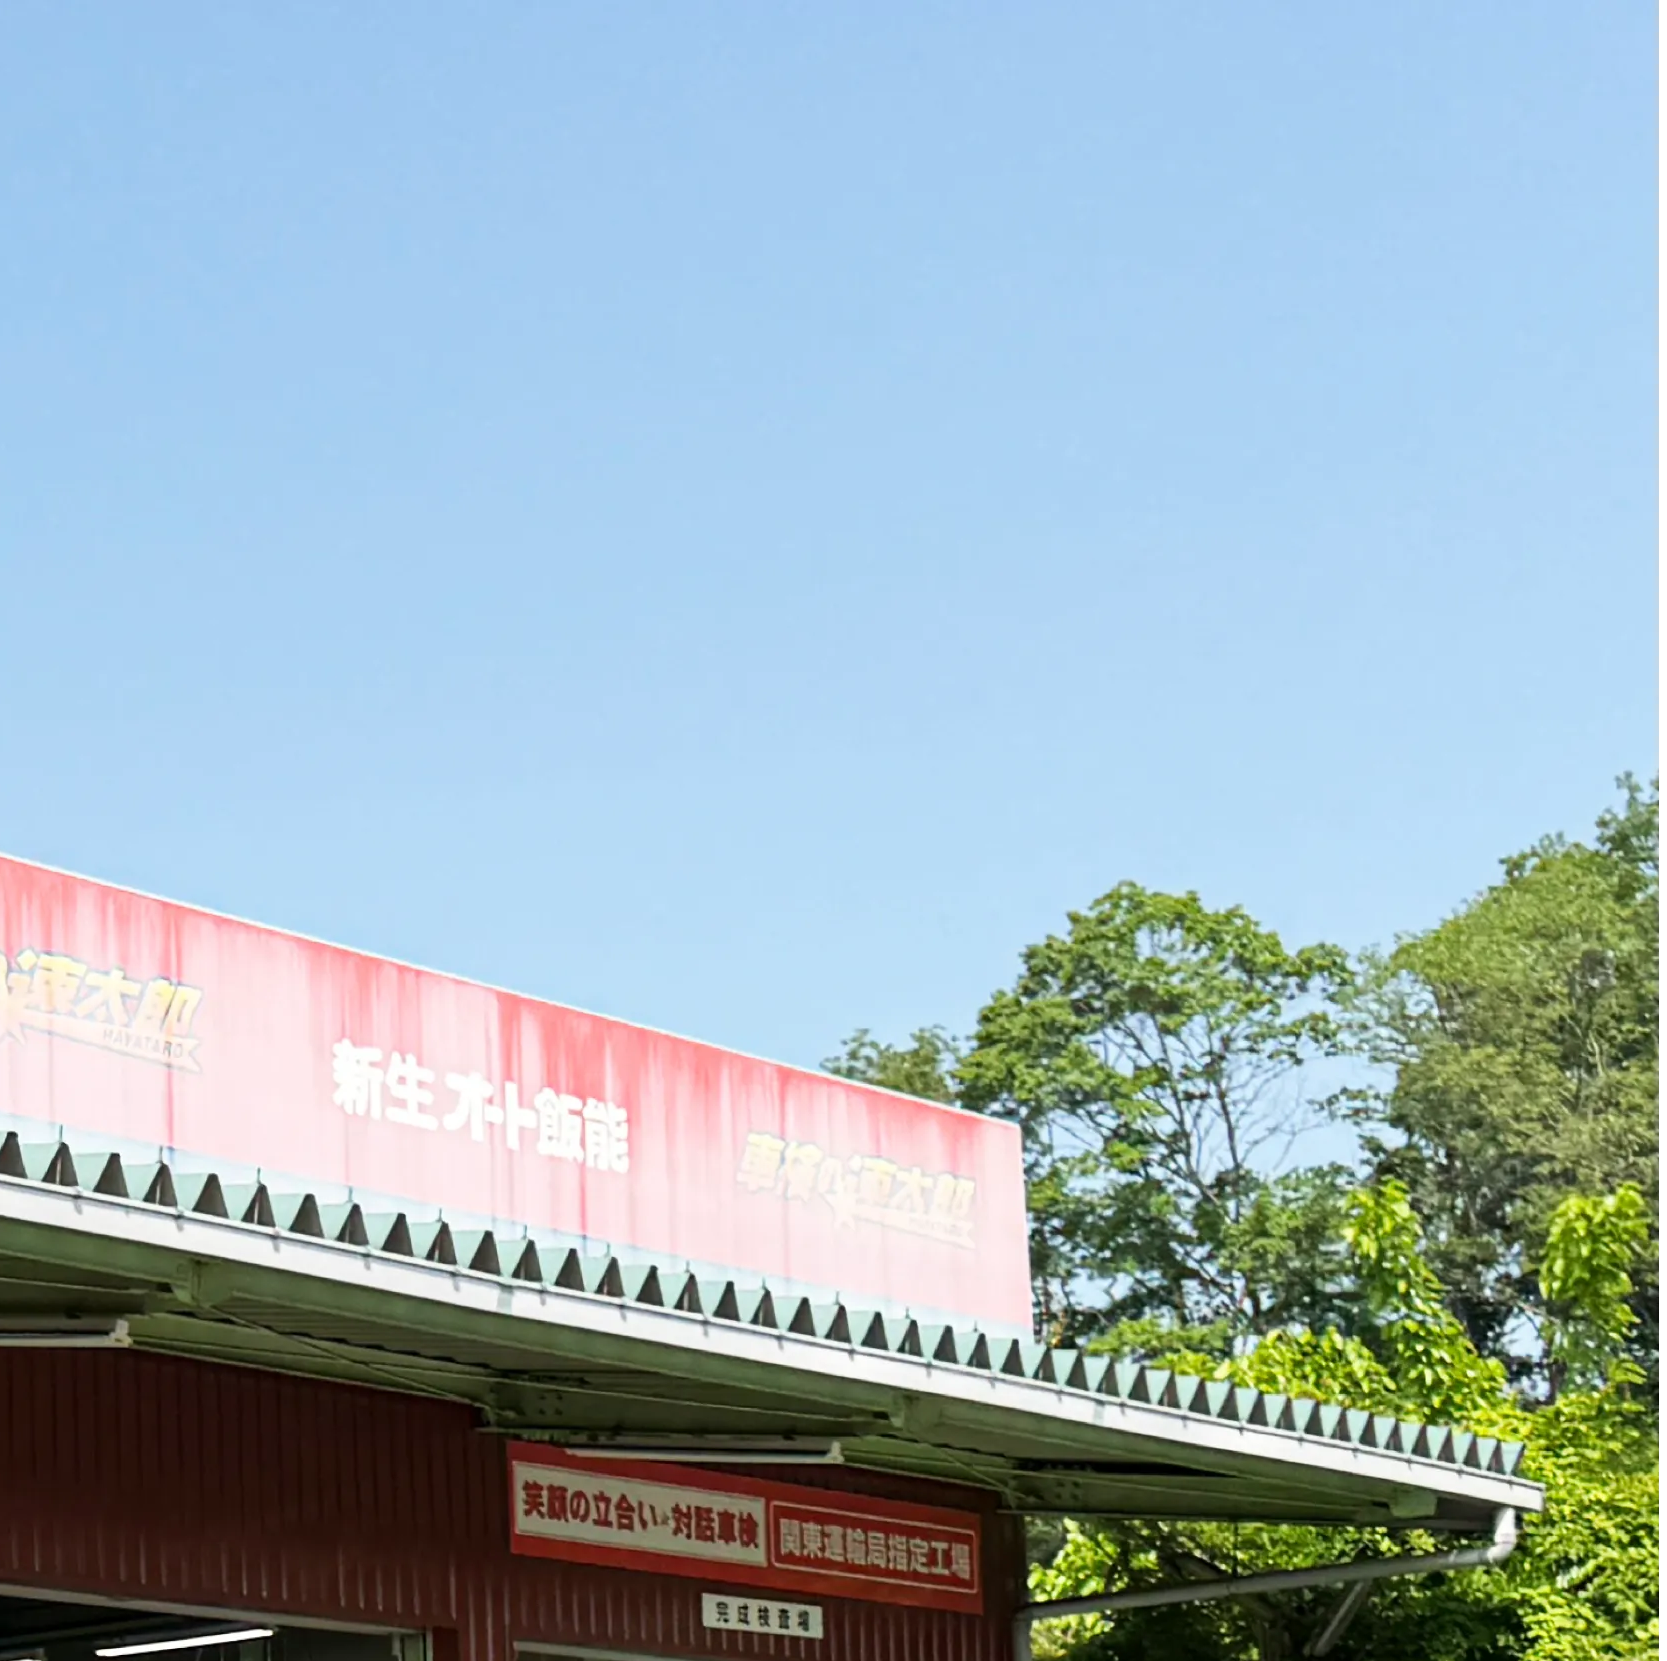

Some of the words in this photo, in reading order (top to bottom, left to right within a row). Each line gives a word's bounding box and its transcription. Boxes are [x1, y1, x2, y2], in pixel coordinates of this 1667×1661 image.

[104, 1028, 184, 1060] HAYATARO
[779, 1518, 970, 1579] 関東運輸局指定工場
